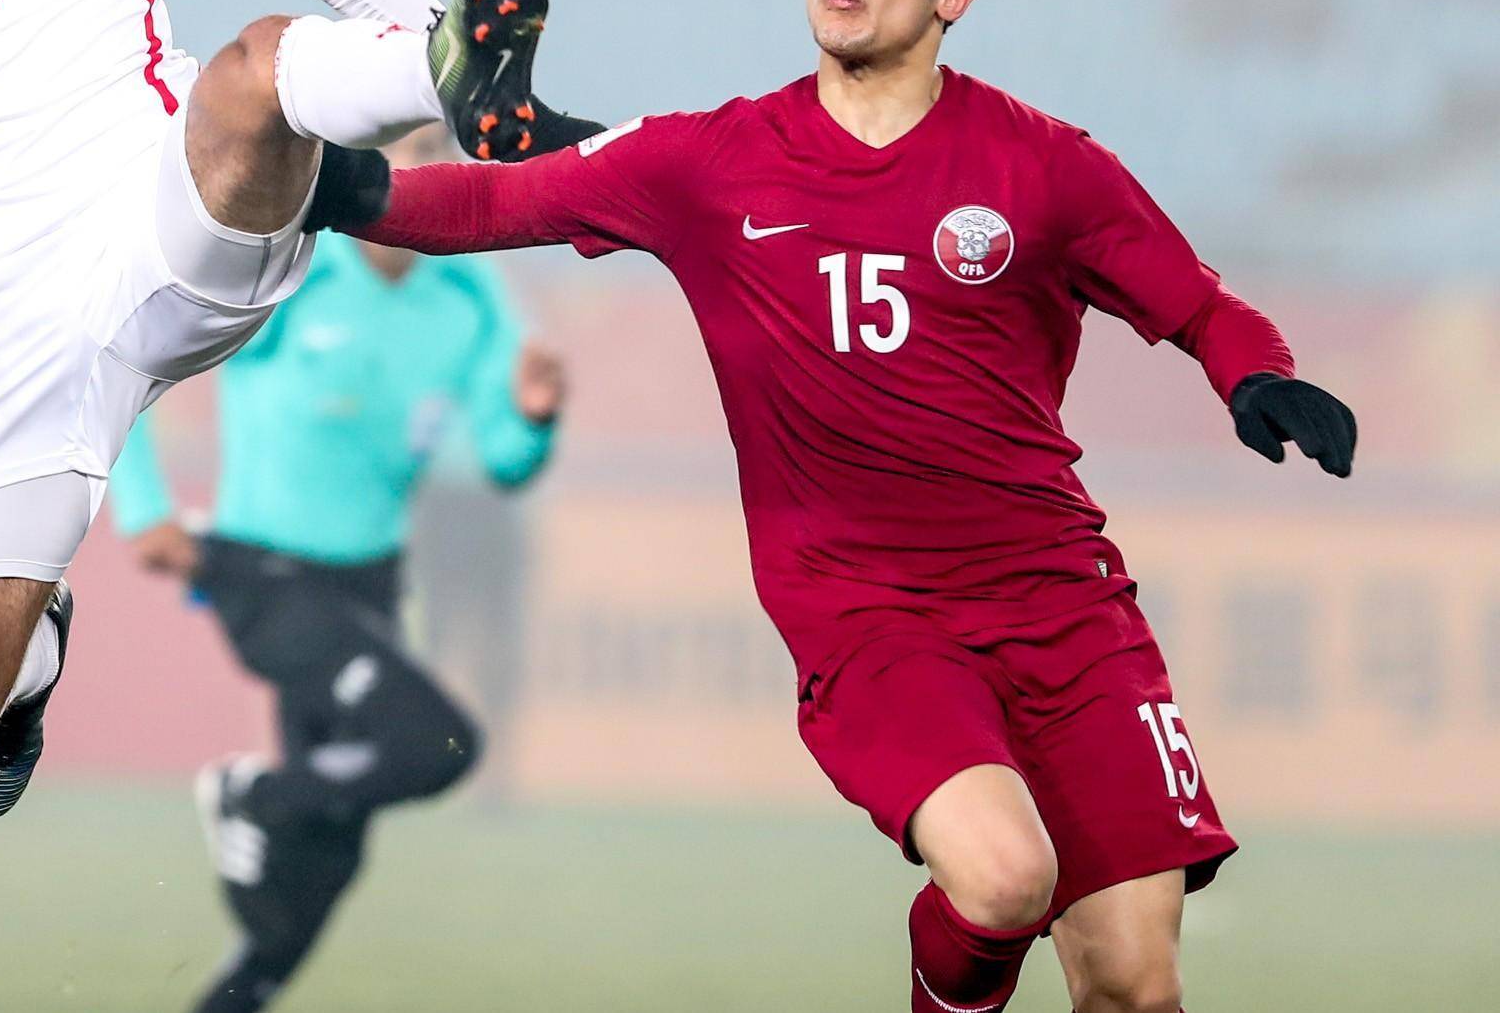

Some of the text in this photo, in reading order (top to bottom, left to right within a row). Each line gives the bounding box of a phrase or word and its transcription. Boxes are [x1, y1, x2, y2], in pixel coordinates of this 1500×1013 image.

[818, 252, 911, 353] 15
[958, 262, 986, 276] QFA
[1137, 701, 1200, 800] 15
